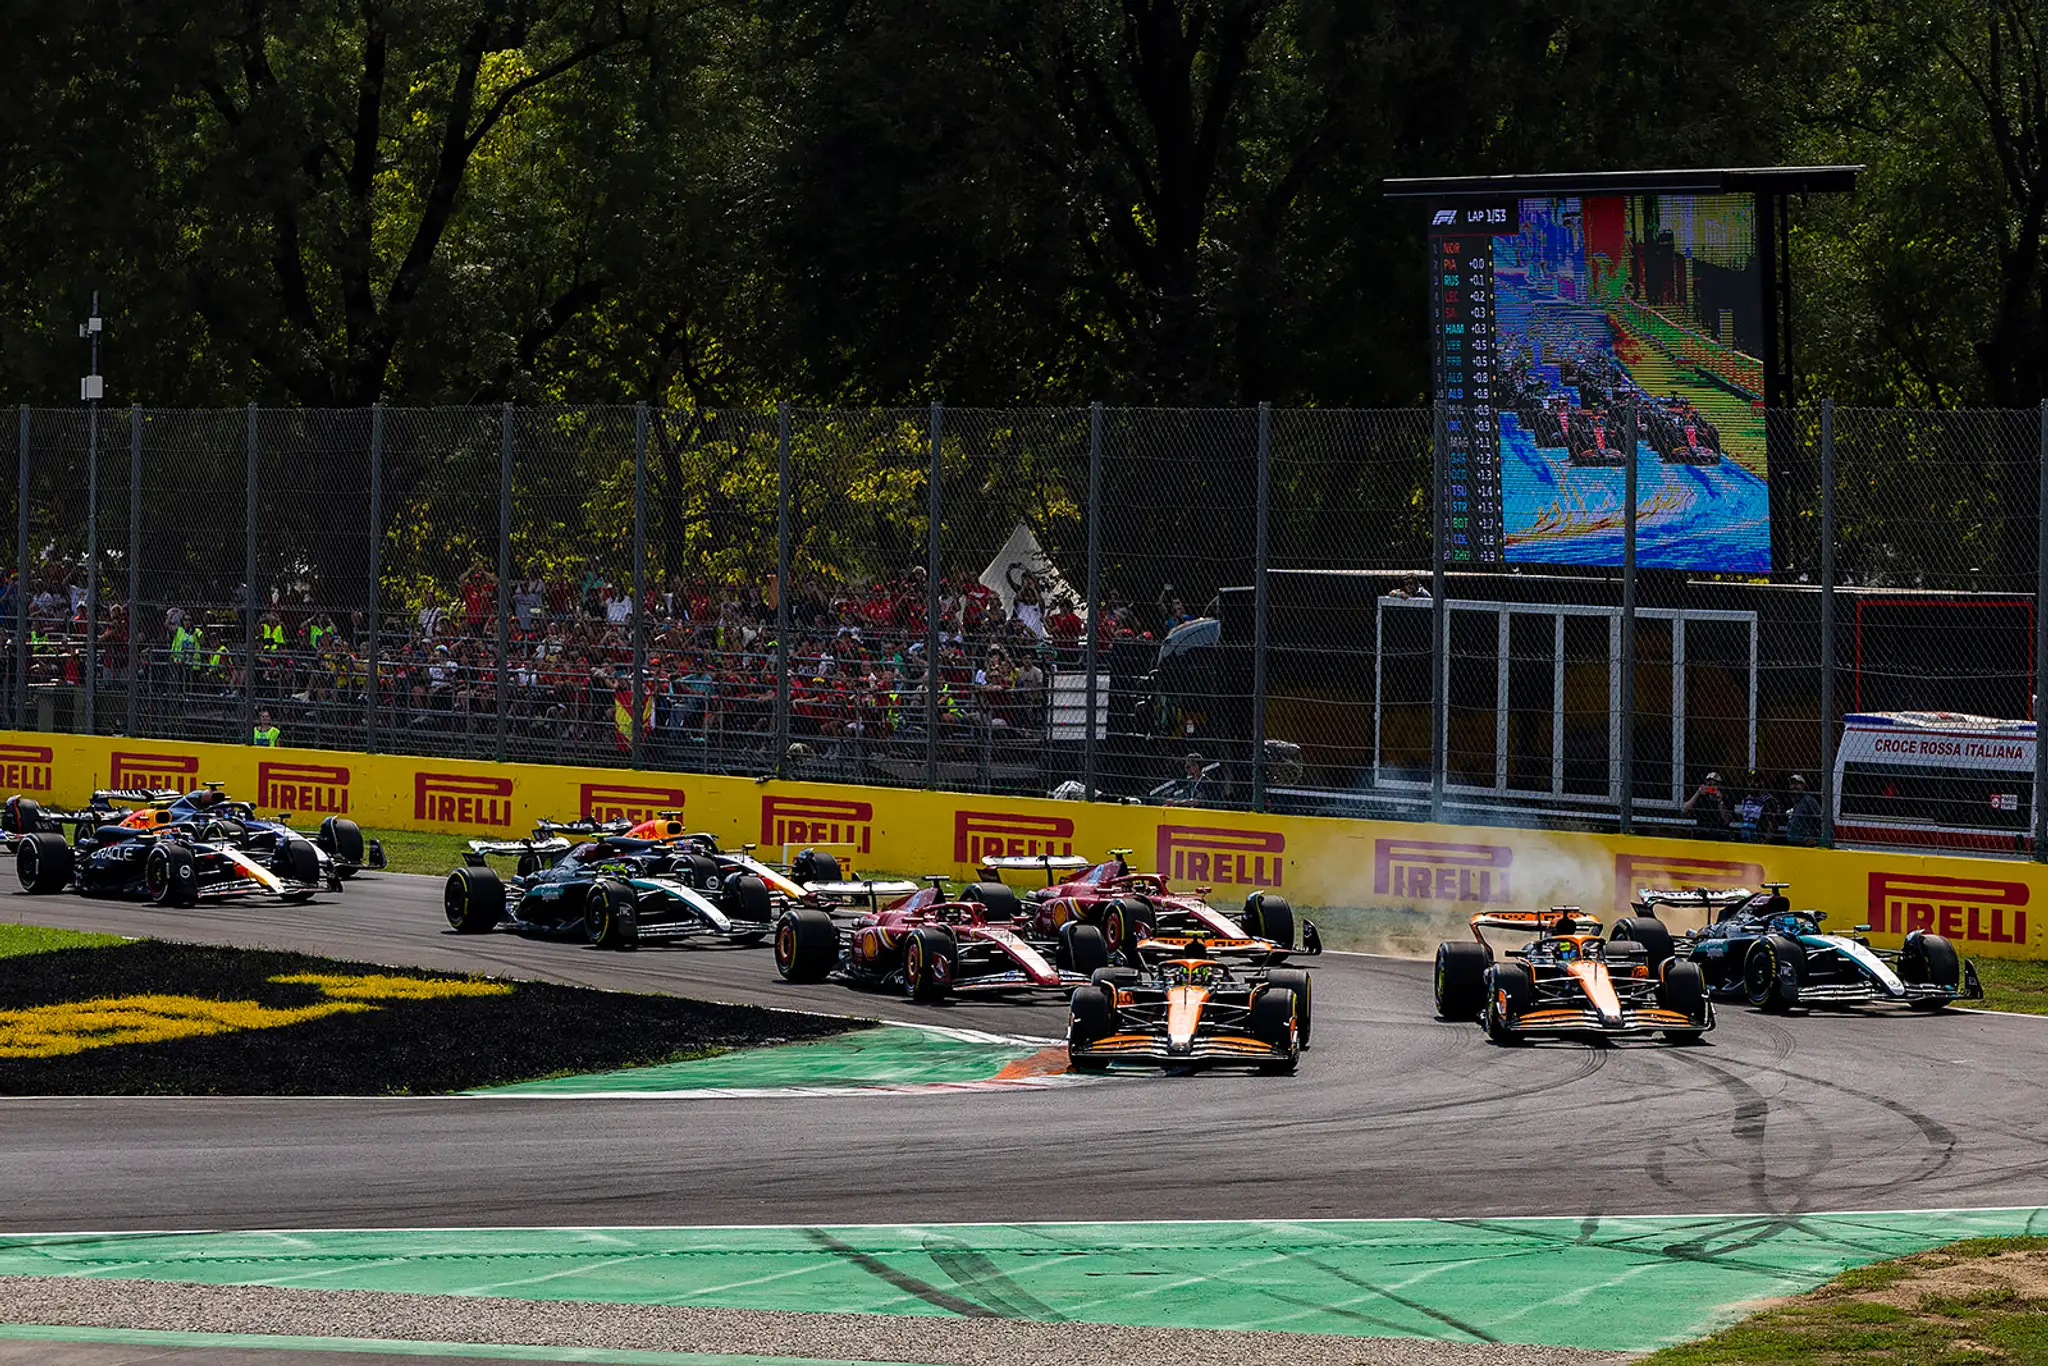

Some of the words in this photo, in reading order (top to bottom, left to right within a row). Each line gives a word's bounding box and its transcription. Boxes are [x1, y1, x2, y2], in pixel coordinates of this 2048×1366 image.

[1467, 211, 1484, 222] LAP
[1486, 209, 1507, 223] 1/53
[1445, 323, 1465, 334] HAM
[1875, 739, 1917, 754] CROCE
[1920, 741, 1961, 756] ROSSA
[1965, 743, 2023, 759] ITALIANA
[258, 762, 350, 814] PIRELLI
[414, 772, 513, 826] PIRELLI
[580, 784, 685, 825] PIREI
[761, 796, 872, 853] PIRELLI
[91, 847, 136, 861] ORACLE
[1156, 824, 1286, 887] PIRELLI
[1374, 838, 1513, 903] PIRELLI
[1868, 872, 2030, 945] PIRELLI
